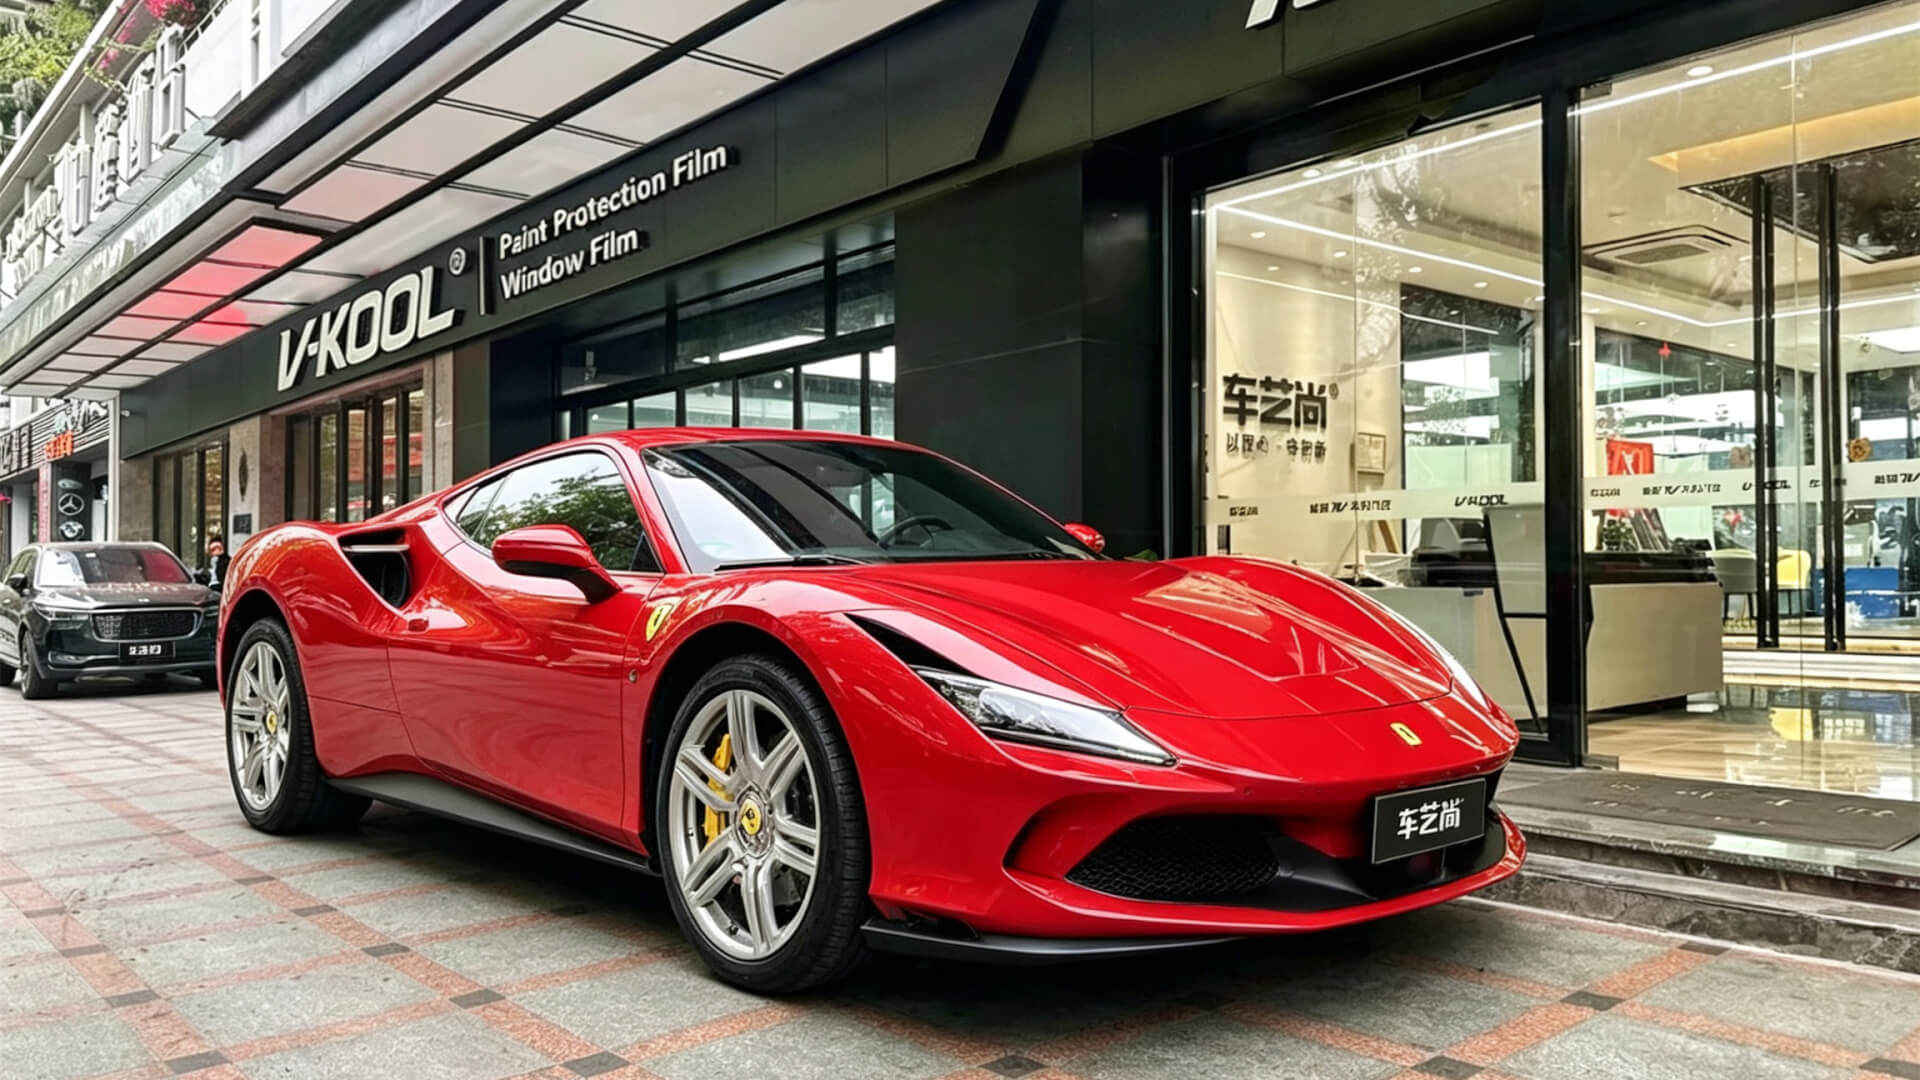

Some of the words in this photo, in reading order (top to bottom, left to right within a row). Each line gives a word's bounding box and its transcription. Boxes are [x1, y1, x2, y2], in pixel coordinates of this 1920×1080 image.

[499, 219, 548, 260] Paint
[553, 171, 666, 237] Protection
[672, 146, 727, 187] Film
[500, 250, 585, 299] Window
[589, 229, 638, 265] Film
[277, 265, 456, 392] V-KOOL
[1222, 373, 1327, 429] 车艺尚
[1397, 798, 1463, 840] 车艺尚
